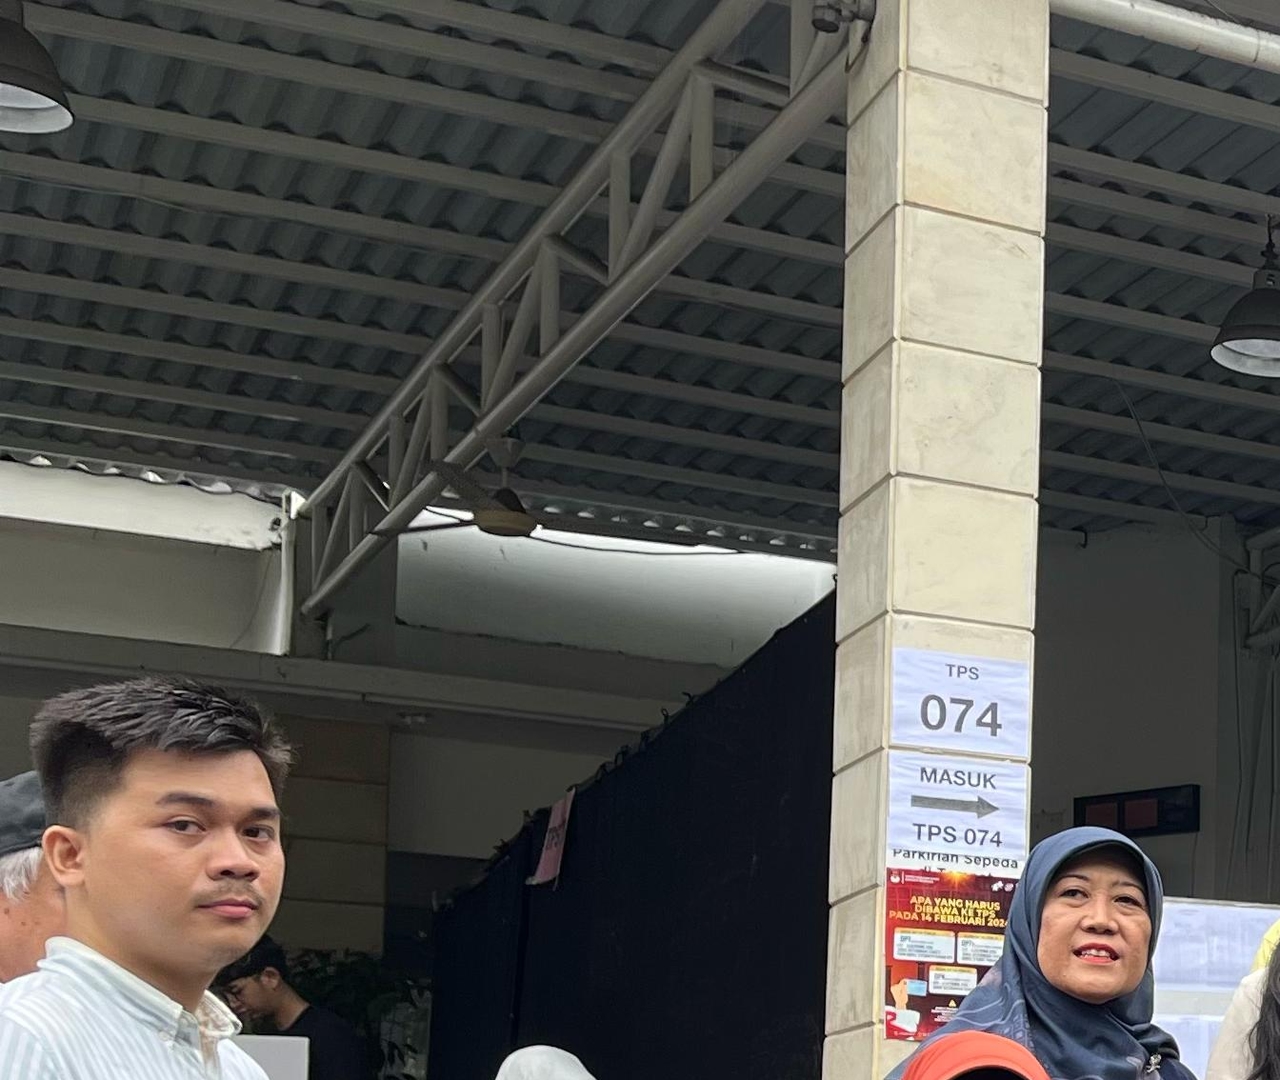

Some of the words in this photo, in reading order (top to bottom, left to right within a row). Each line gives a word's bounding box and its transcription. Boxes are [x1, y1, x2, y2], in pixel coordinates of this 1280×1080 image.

[945, 663, 980, 681] TPS
[920, 694, 1003, 737] 074
[920, 767, 997, 790] MASUK
[912, 823, 957, 843] TPS
[964, 828, 1003, 848] 074
[910, 895, 932, 906] APA
[934, 898, 963, 908] YANG
[965, 900, 1001, 911] HARUS
[915, 904, 959, 916] DIBAWA
[977, 909, 996, 919] TPS
[889, 910, 919, 921] PADA
[921, 912, 932, 922] 14
[935, 915, 985, 927] FEBRUARI
